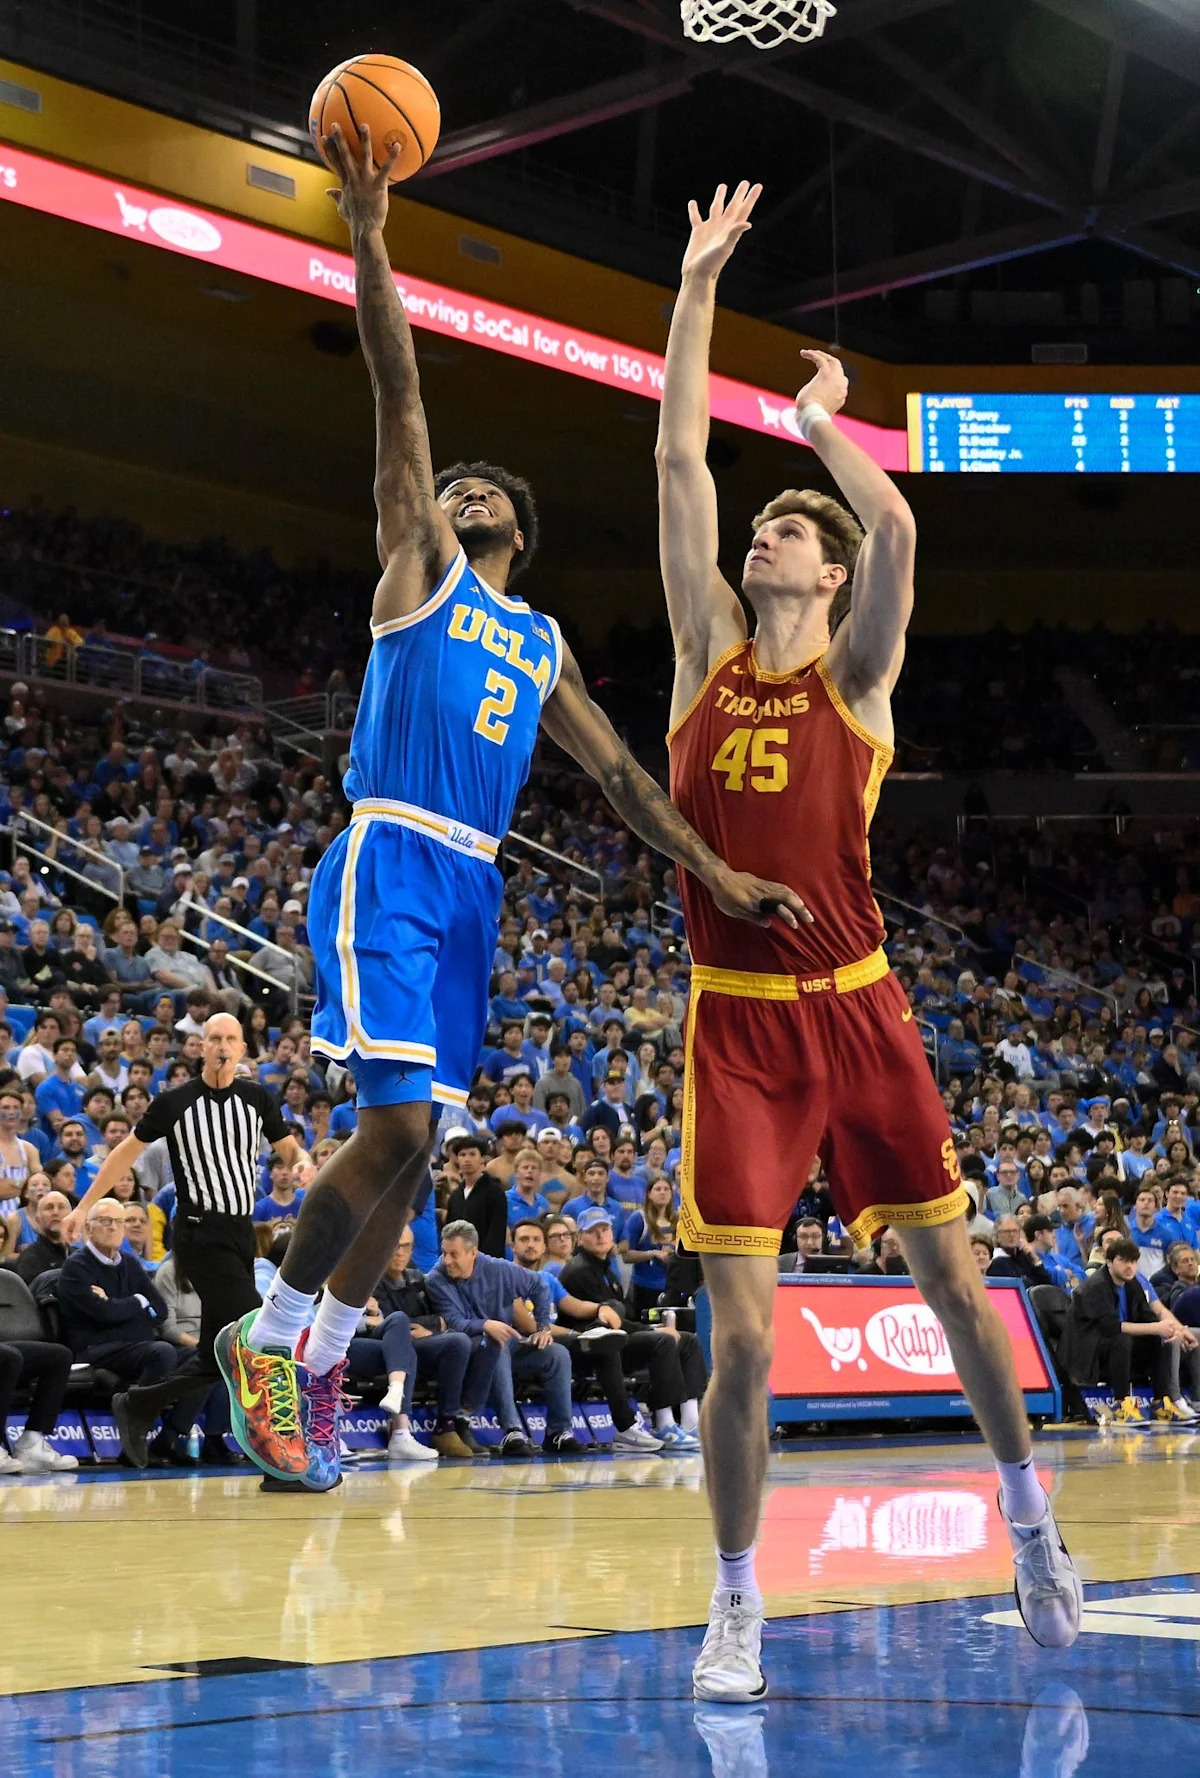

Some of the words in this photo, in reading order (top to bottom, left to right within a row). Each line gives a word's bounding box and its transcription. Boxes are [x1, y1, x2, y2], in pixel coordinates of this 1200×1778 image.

[309, 258, 356, 294] Prou
[473, 310, 529, 347] SoCal
[533, 329, 560, 357] for
[564, 340, 609, 372] Over
[612, 353, 643, 382] 150
[448, 604, 551, 706] UCLA
[473, 668, 518, 746] 2
[715, 685, 810, 724] TROJANS
[712, 728, 788, 792] 45
[802, 978, 831, 993] USC
[880, 1314, 946, 1368] Ralph
